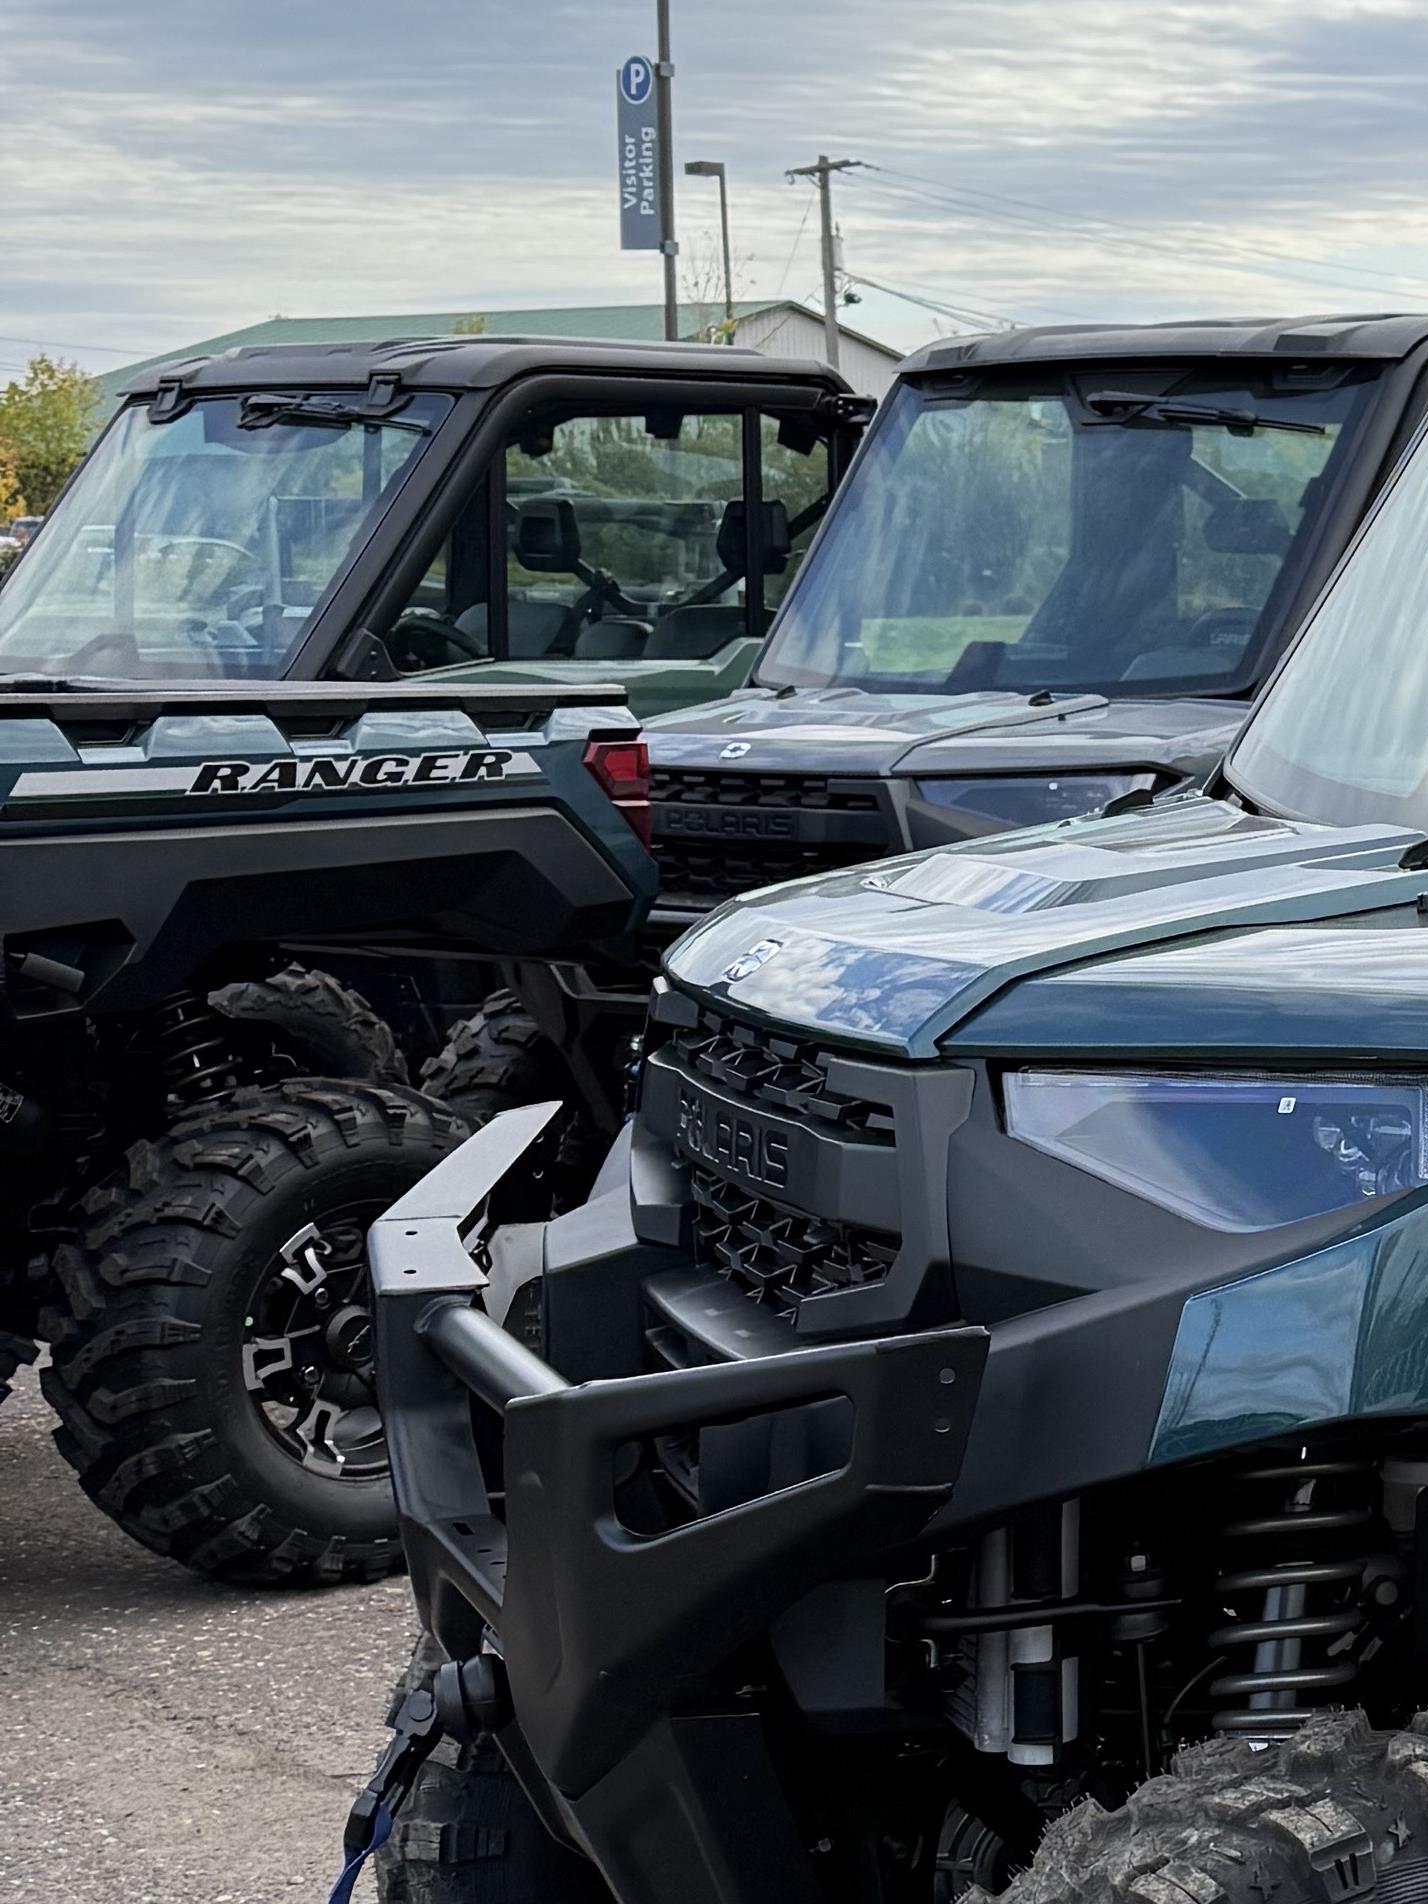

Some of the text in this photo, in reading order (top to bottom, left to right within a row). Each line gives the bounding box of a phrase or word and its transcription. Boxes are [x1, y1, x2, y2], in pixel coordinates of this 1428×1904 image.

[629, 62, 646, 96] P
[622, 133, 638, 209] Visitor
[638, 126, 657, 215] Parking
[186, 750, 513, 796] RANGER
[664, 806, 794, 840] POLARIS
[678, 1092, 789, 1189] POLARIS
